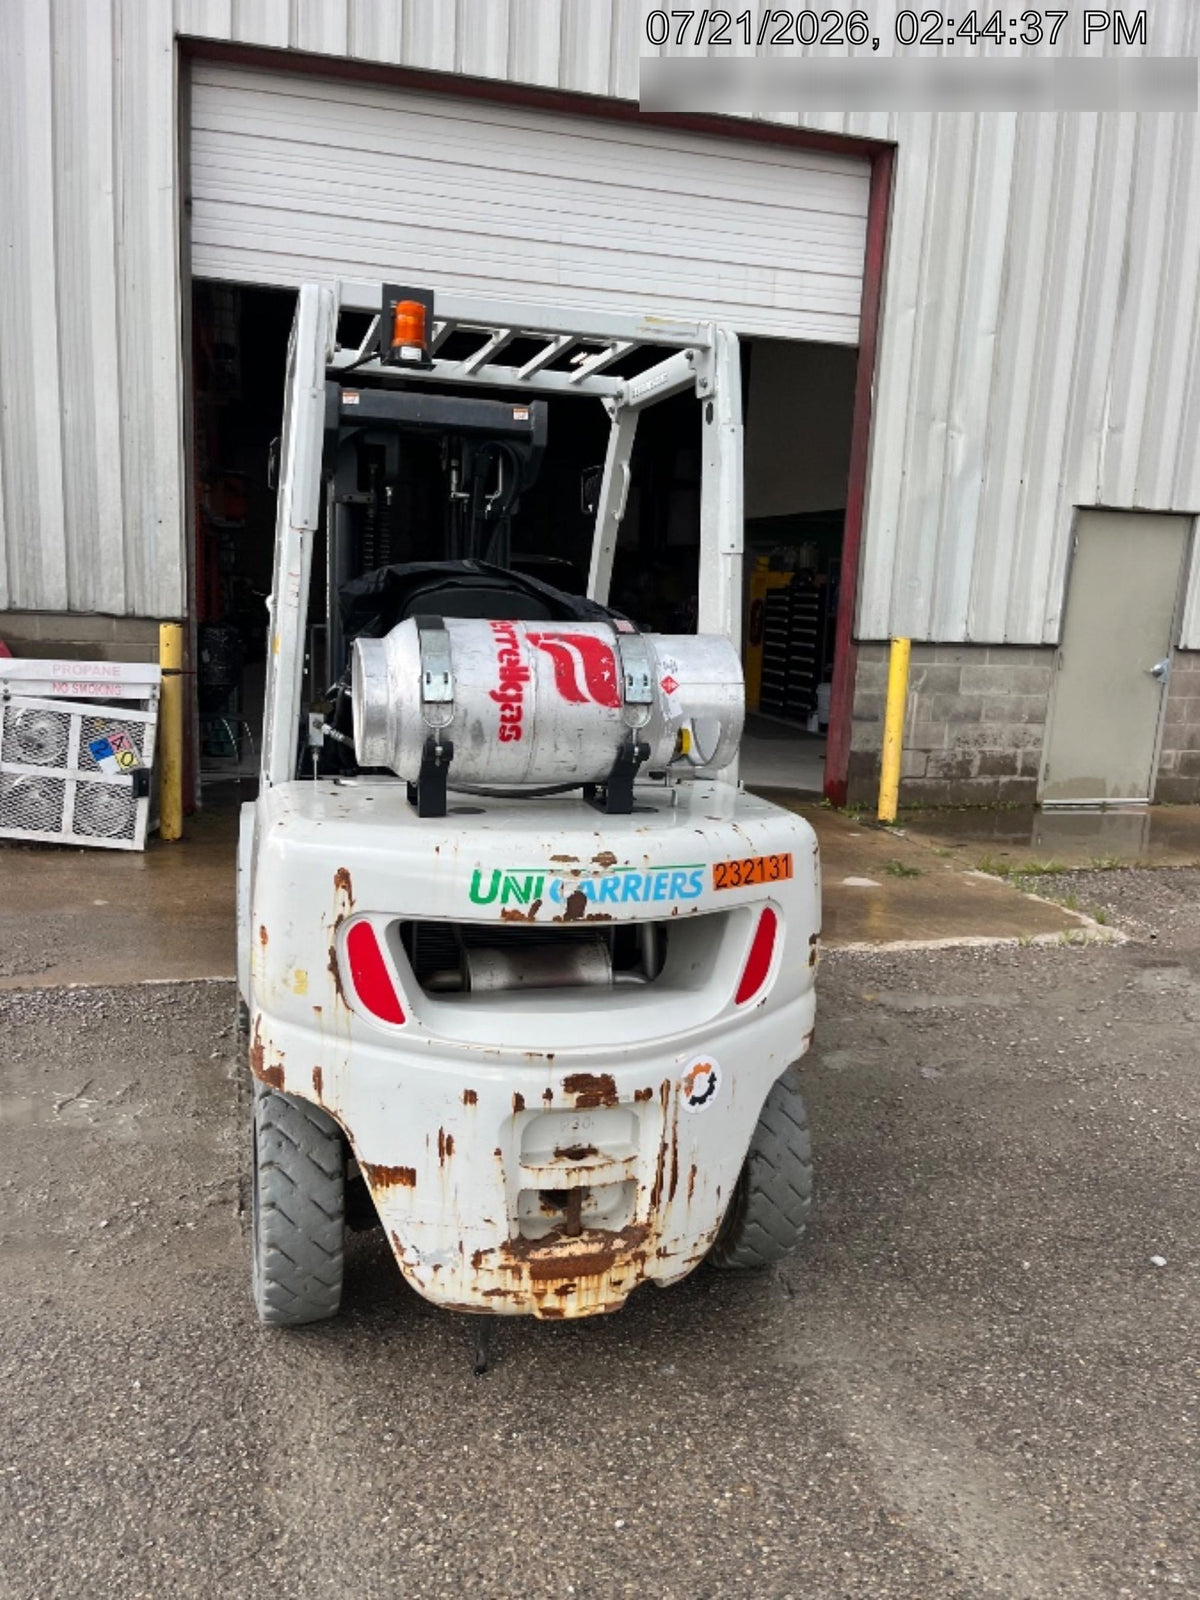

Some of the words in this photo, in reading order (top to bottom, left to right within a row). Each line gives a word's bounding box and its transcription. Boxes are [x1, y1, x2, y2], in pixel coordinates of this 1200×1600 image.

[52, 663, 121, 677] PROPANE
[489, 619, 530, 742] errellgas
[52, 681, 69, 694] NO
[72, 682, 122, 696] SMOKING
[714, 853, 790, 890] 232131
